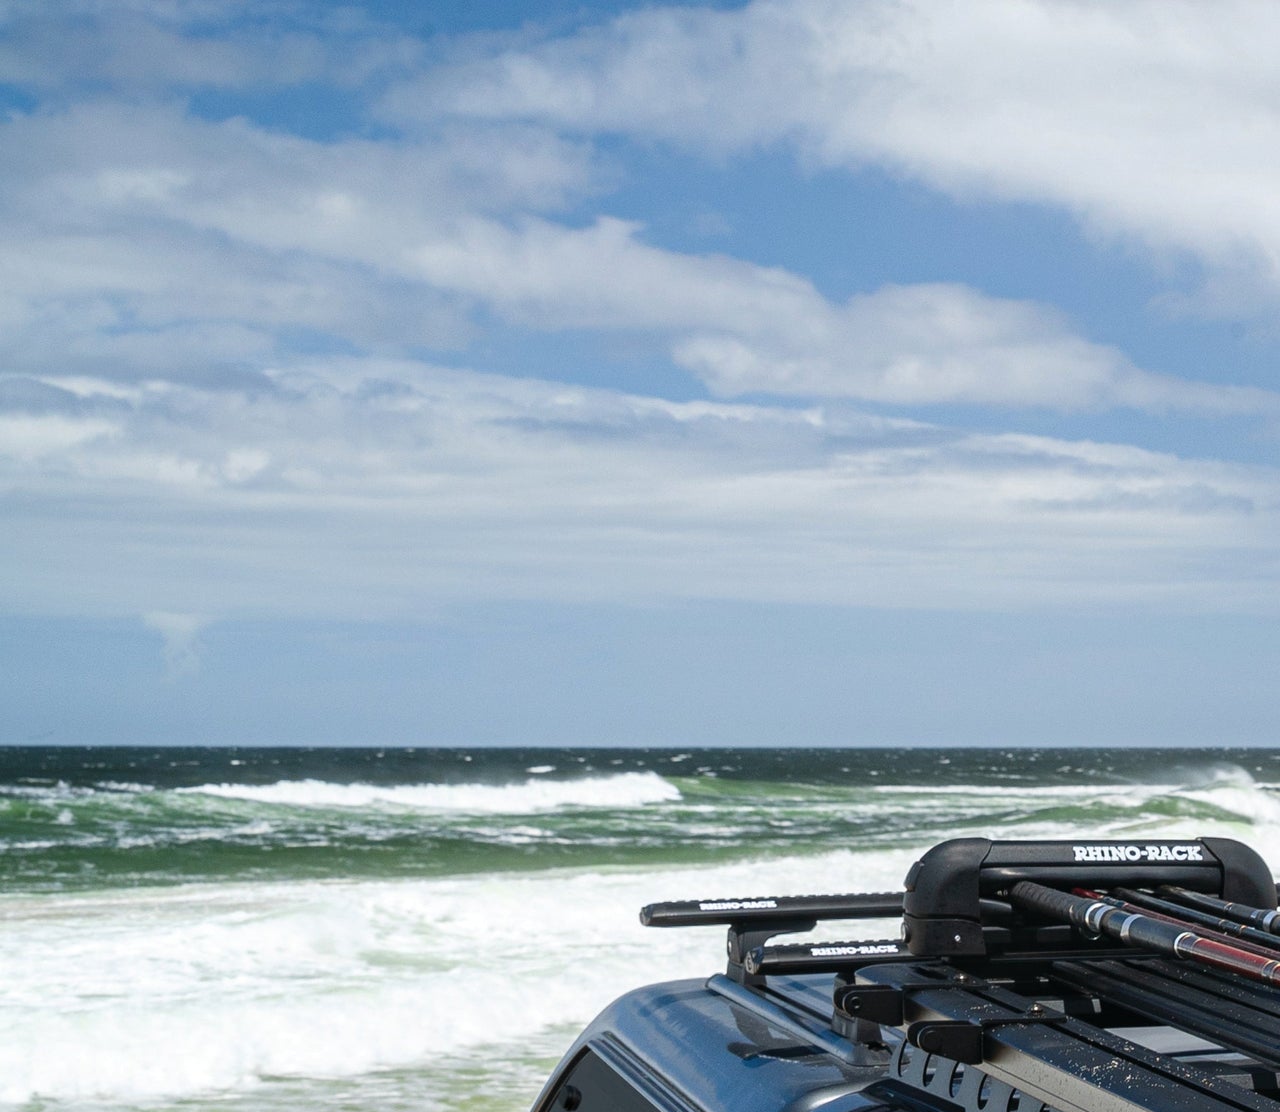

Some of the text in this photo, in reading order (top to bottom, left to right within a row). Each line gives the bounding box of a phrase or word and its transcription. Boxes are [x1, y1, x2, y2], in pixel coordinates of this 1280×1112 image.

[1073, 845, 1203, 861] RHINO-RACK
[699, 900, 777, 911] RHINO-RACK
[811, 944, 899, 957] RHINO-RACK
